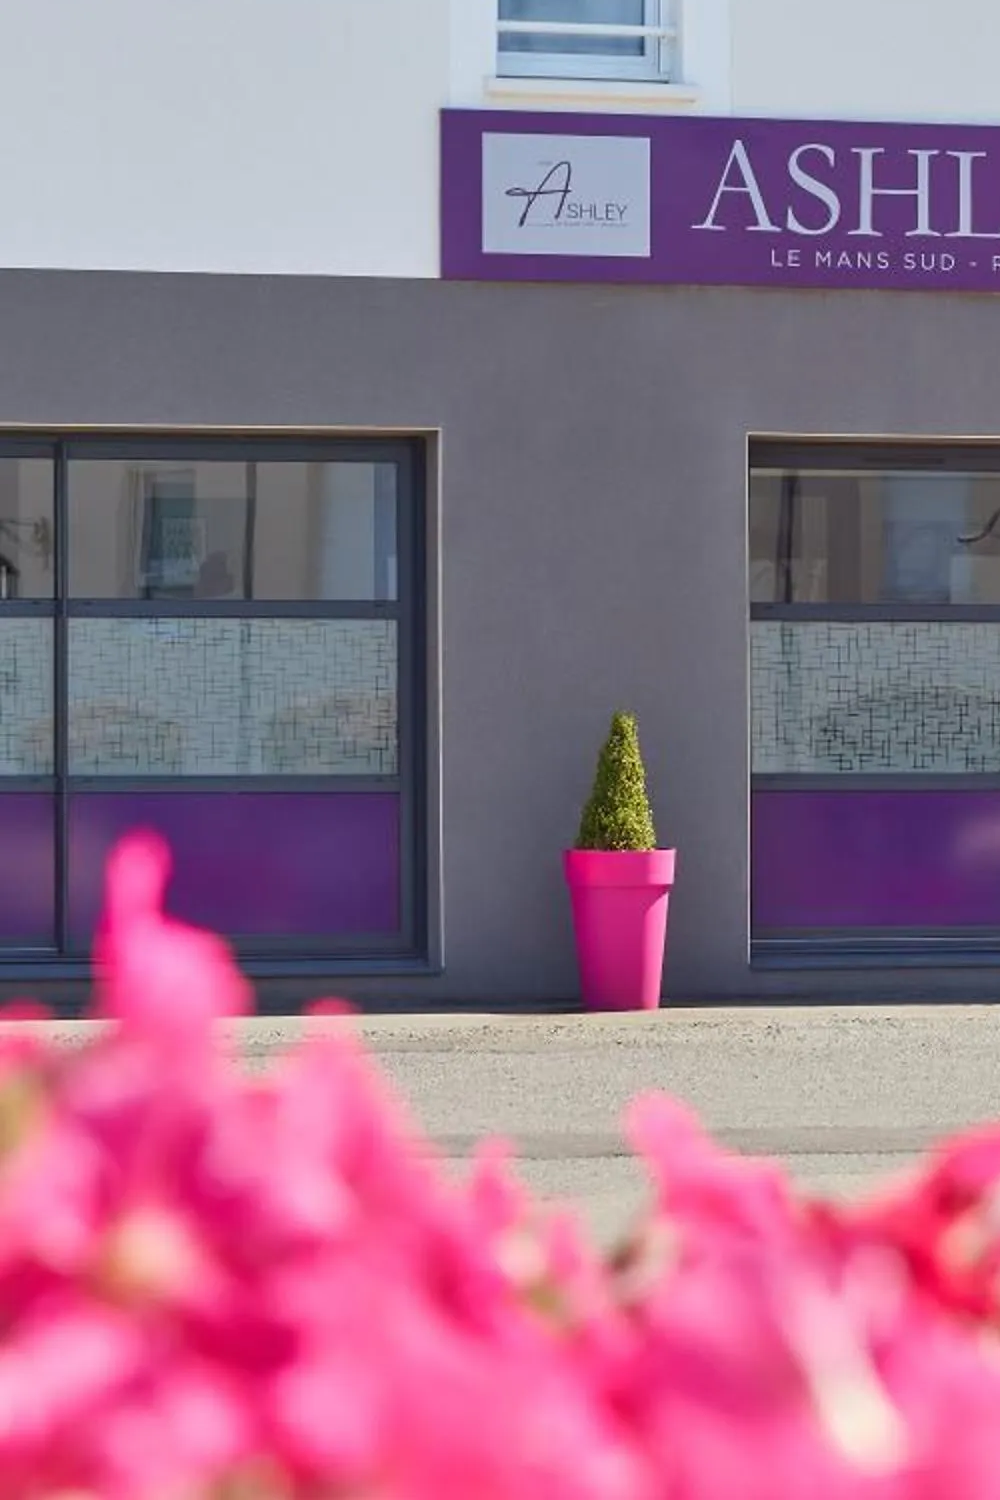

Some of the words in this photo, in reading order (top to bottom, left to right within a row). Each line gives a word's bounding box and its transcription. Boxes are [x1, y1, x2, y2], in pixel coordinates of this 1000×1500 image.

[505, 161, 628, 227] ASHLEY
[771, 249, 801, 267] LE
[815, 251, 890, 269] MANS
[903, 253, 955, 271] SUD
